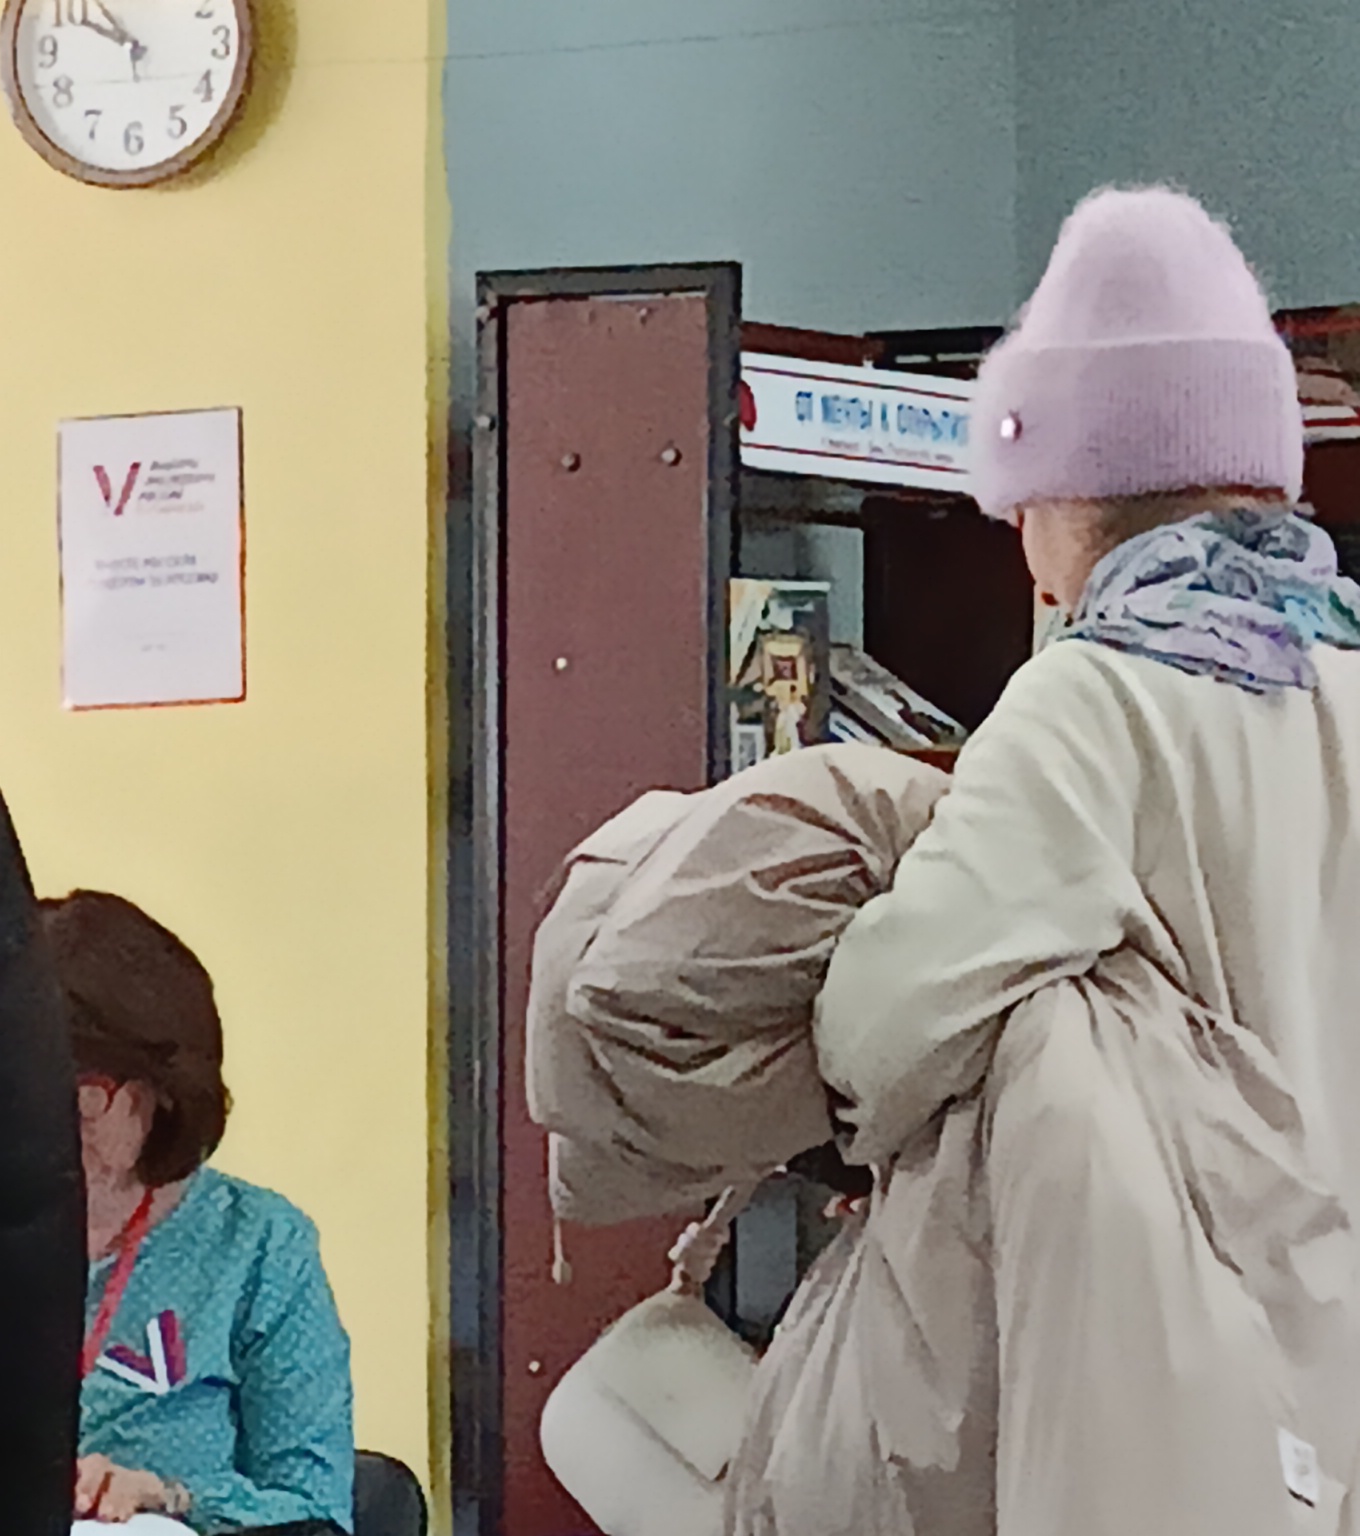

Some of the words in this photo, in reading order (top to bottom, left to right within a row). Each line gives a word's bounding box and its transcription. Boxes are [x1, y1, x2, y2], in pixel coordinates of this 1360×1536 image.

[38, 34, 58, 68] 9
[211, 25, 230, 59] 3
[52, 74, 74, 108] 8
[193, 69, 214, 102] 4
[84, 109, 102, 139] 7
[123, 121, 144, 155] 6
[166, 105, 187, 139] 5
